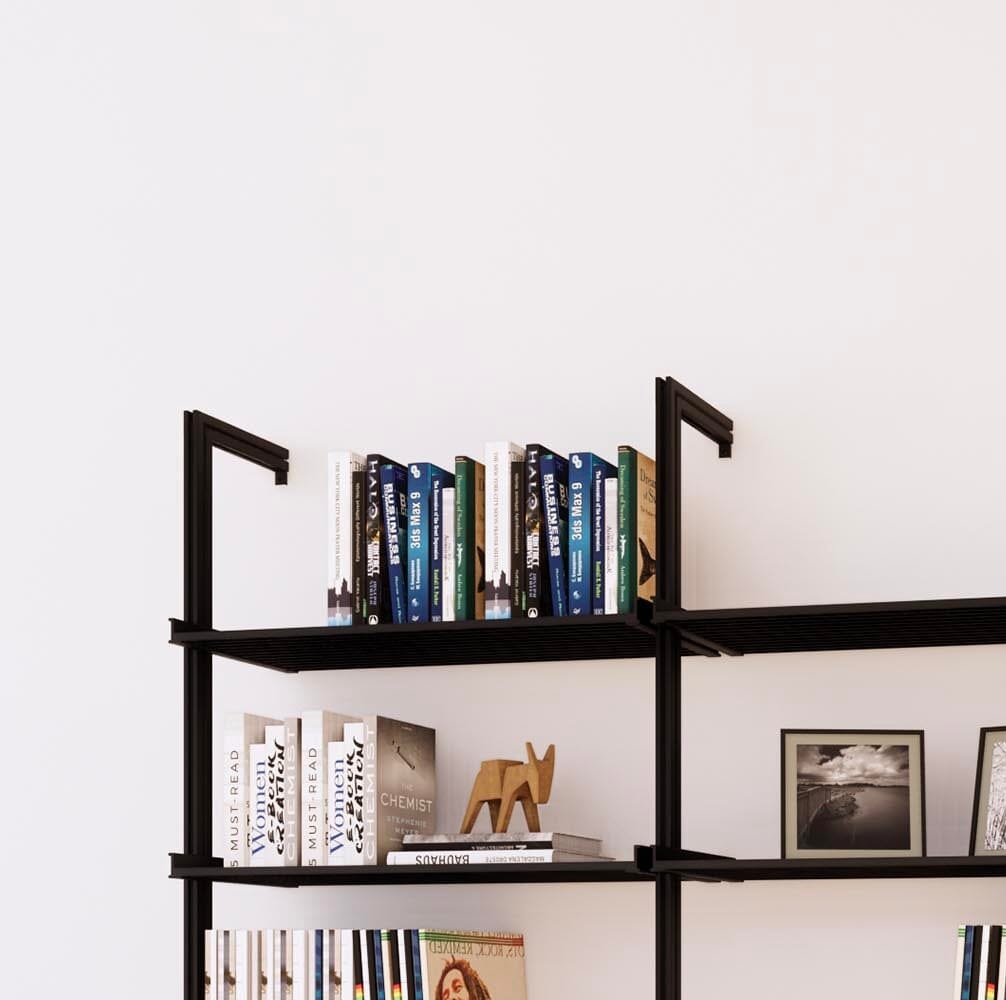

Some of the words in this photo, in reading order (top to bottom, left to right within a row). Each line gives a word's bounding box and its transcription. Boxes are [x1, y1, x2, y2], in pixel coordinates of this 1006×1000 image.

[368, 460, 378, 520] HALO
[410, 492, 421, 500] 9
[410, 502, 421, 526] Max
[528, 450, 538, 510] HALO
[547, 474, 560, 556] BUSINESS
[572, 482, 582, 490] 9
[572, 493, 582, 517] Max
[386, 483, 400, 565] BUSINESS
[410, 528, 421, 548] 3ds
[572, 520, 582, 540] 3ds
[230, 750, 238, 850] MUST-READ
[252, 761, 266, 855] Women
[267, 750, 276, 843] E-BOOK
[274, 738, 285, 855] CREATION
[287, 728, 296, 860] CHEMIST
[308, 748, 317, 849] MUST-READ
[330, 759, 344, 854] Women
[346, 748, 355, 842] E-BOOK
[354, 736, 364, 854] CREATION
[366, 724, 374, 860] CHEMIST
[380, 792, 432, 813] CHEMIST
[416, 854, 469, 864] BAUHAUS
